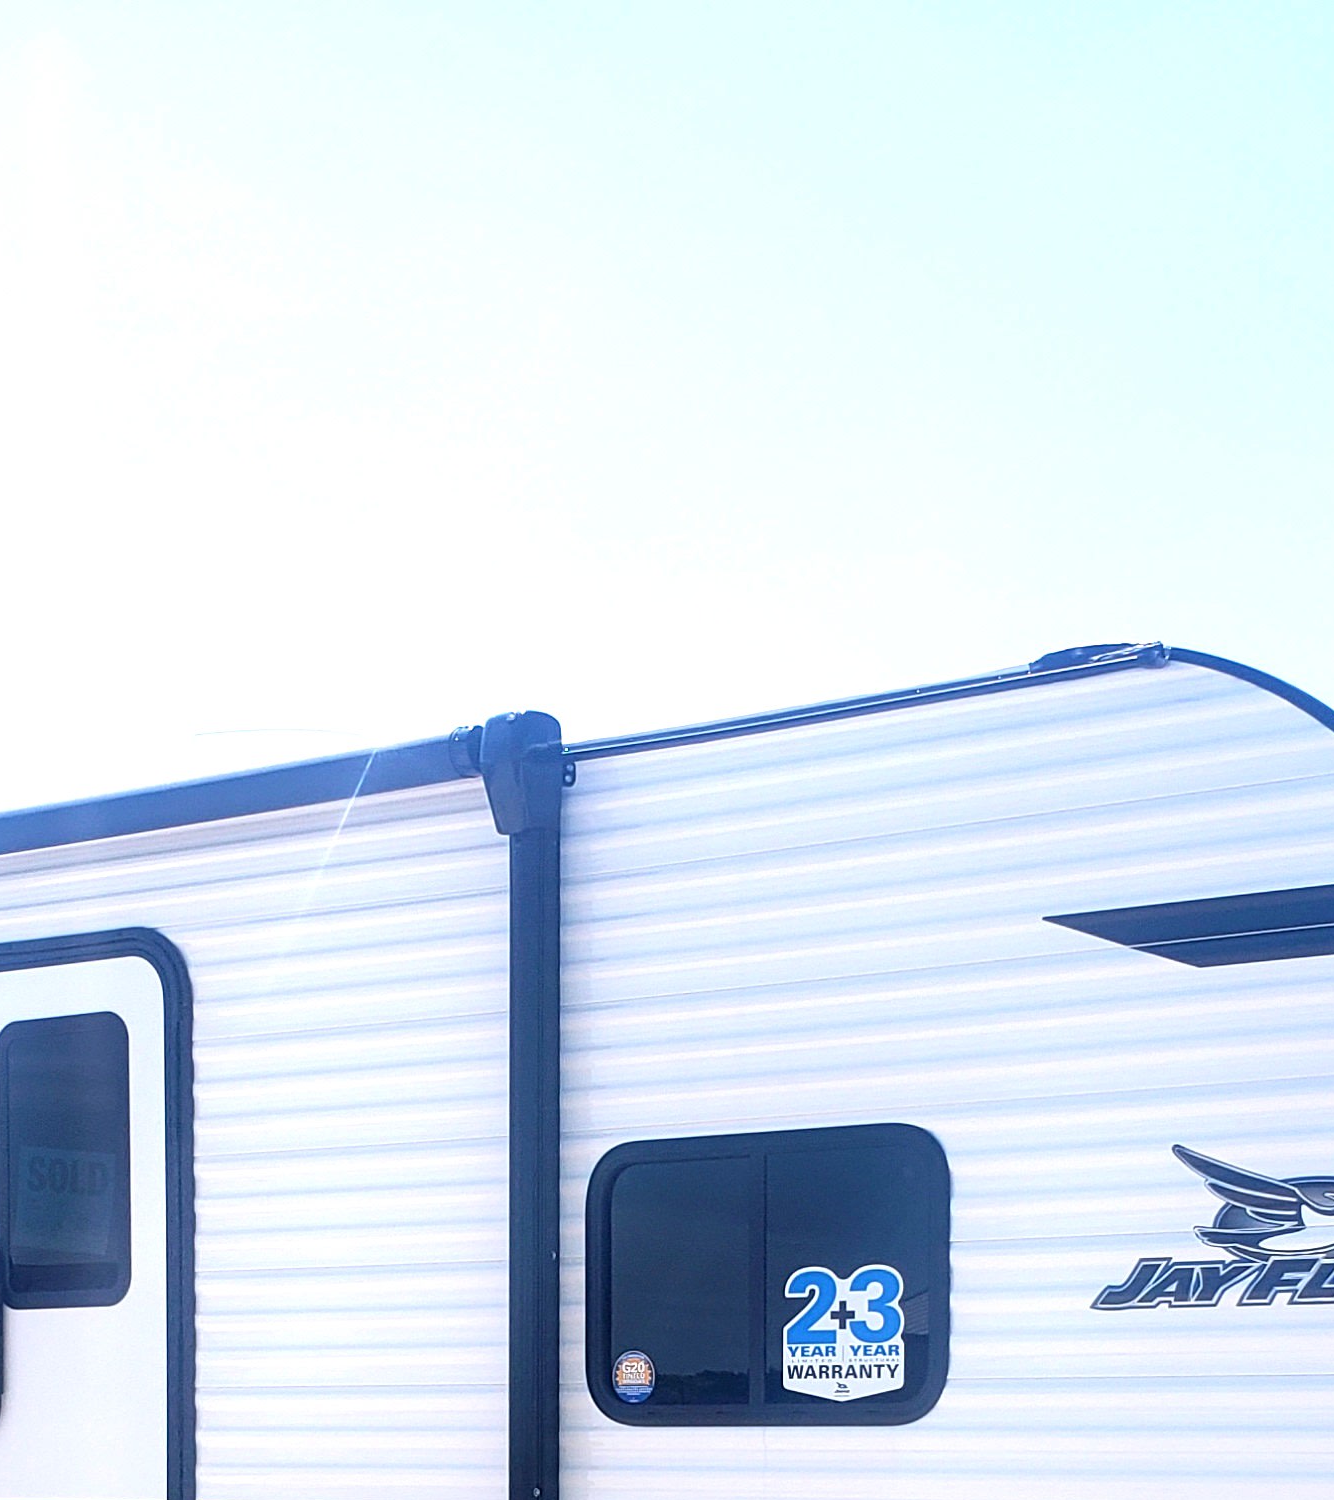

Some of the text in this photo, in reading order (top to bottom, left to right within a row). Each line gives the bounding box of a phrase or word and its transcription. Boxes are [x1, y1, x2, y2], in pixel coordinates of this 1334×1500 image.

[27, 1155, 108, 1197] SOLD
[1090, 1257, 1257, 1310] JAY
[787, 1345, 837, 1358] YEAR
[849, 1344, 900, 1357] YEAR
[622, 1362, 645, 1374] G20
[787, 1363, 899, 1380] WARRANTY
